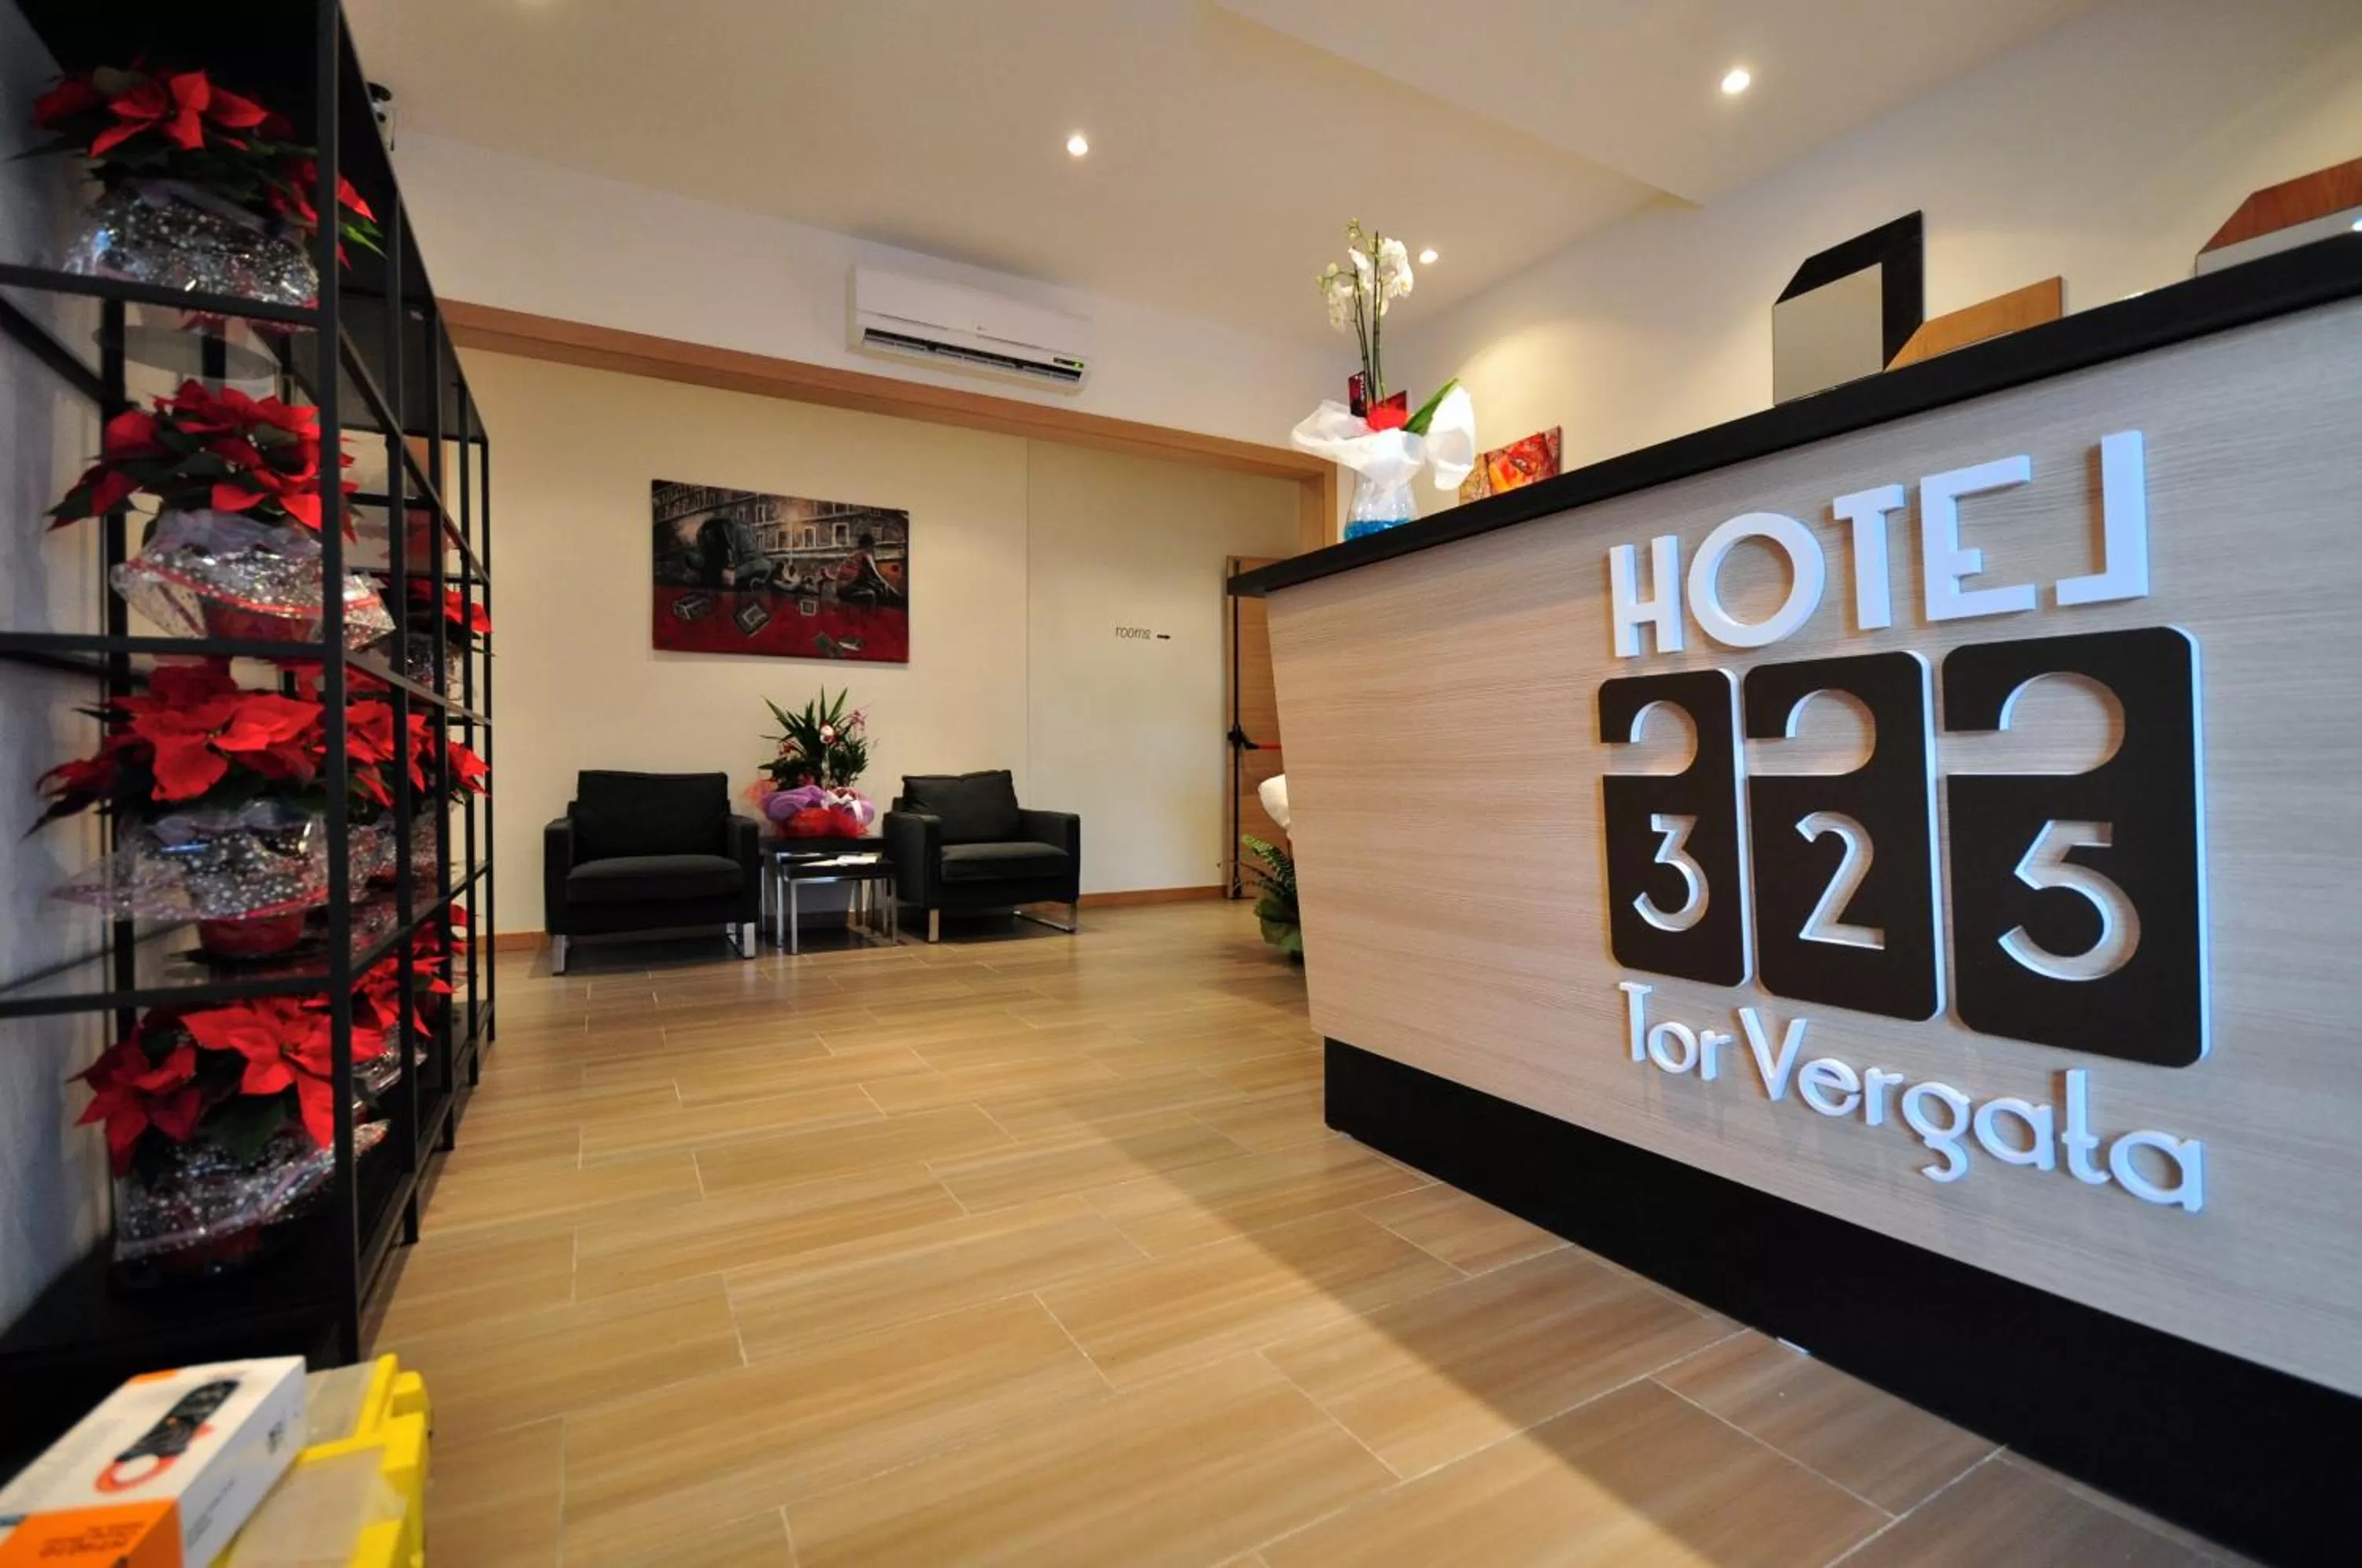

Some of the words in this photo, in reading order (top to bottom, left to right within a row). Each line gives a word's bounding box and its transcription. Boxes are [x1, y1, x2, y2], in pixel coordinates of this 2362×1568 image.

[1115, 627, 1152, 640] rooms
[1609, 430, 2149, 658] HOTEL
[1619, 981, 1731, 1081] Tor
[1738, 1007, 2204, 1213] Vergata
